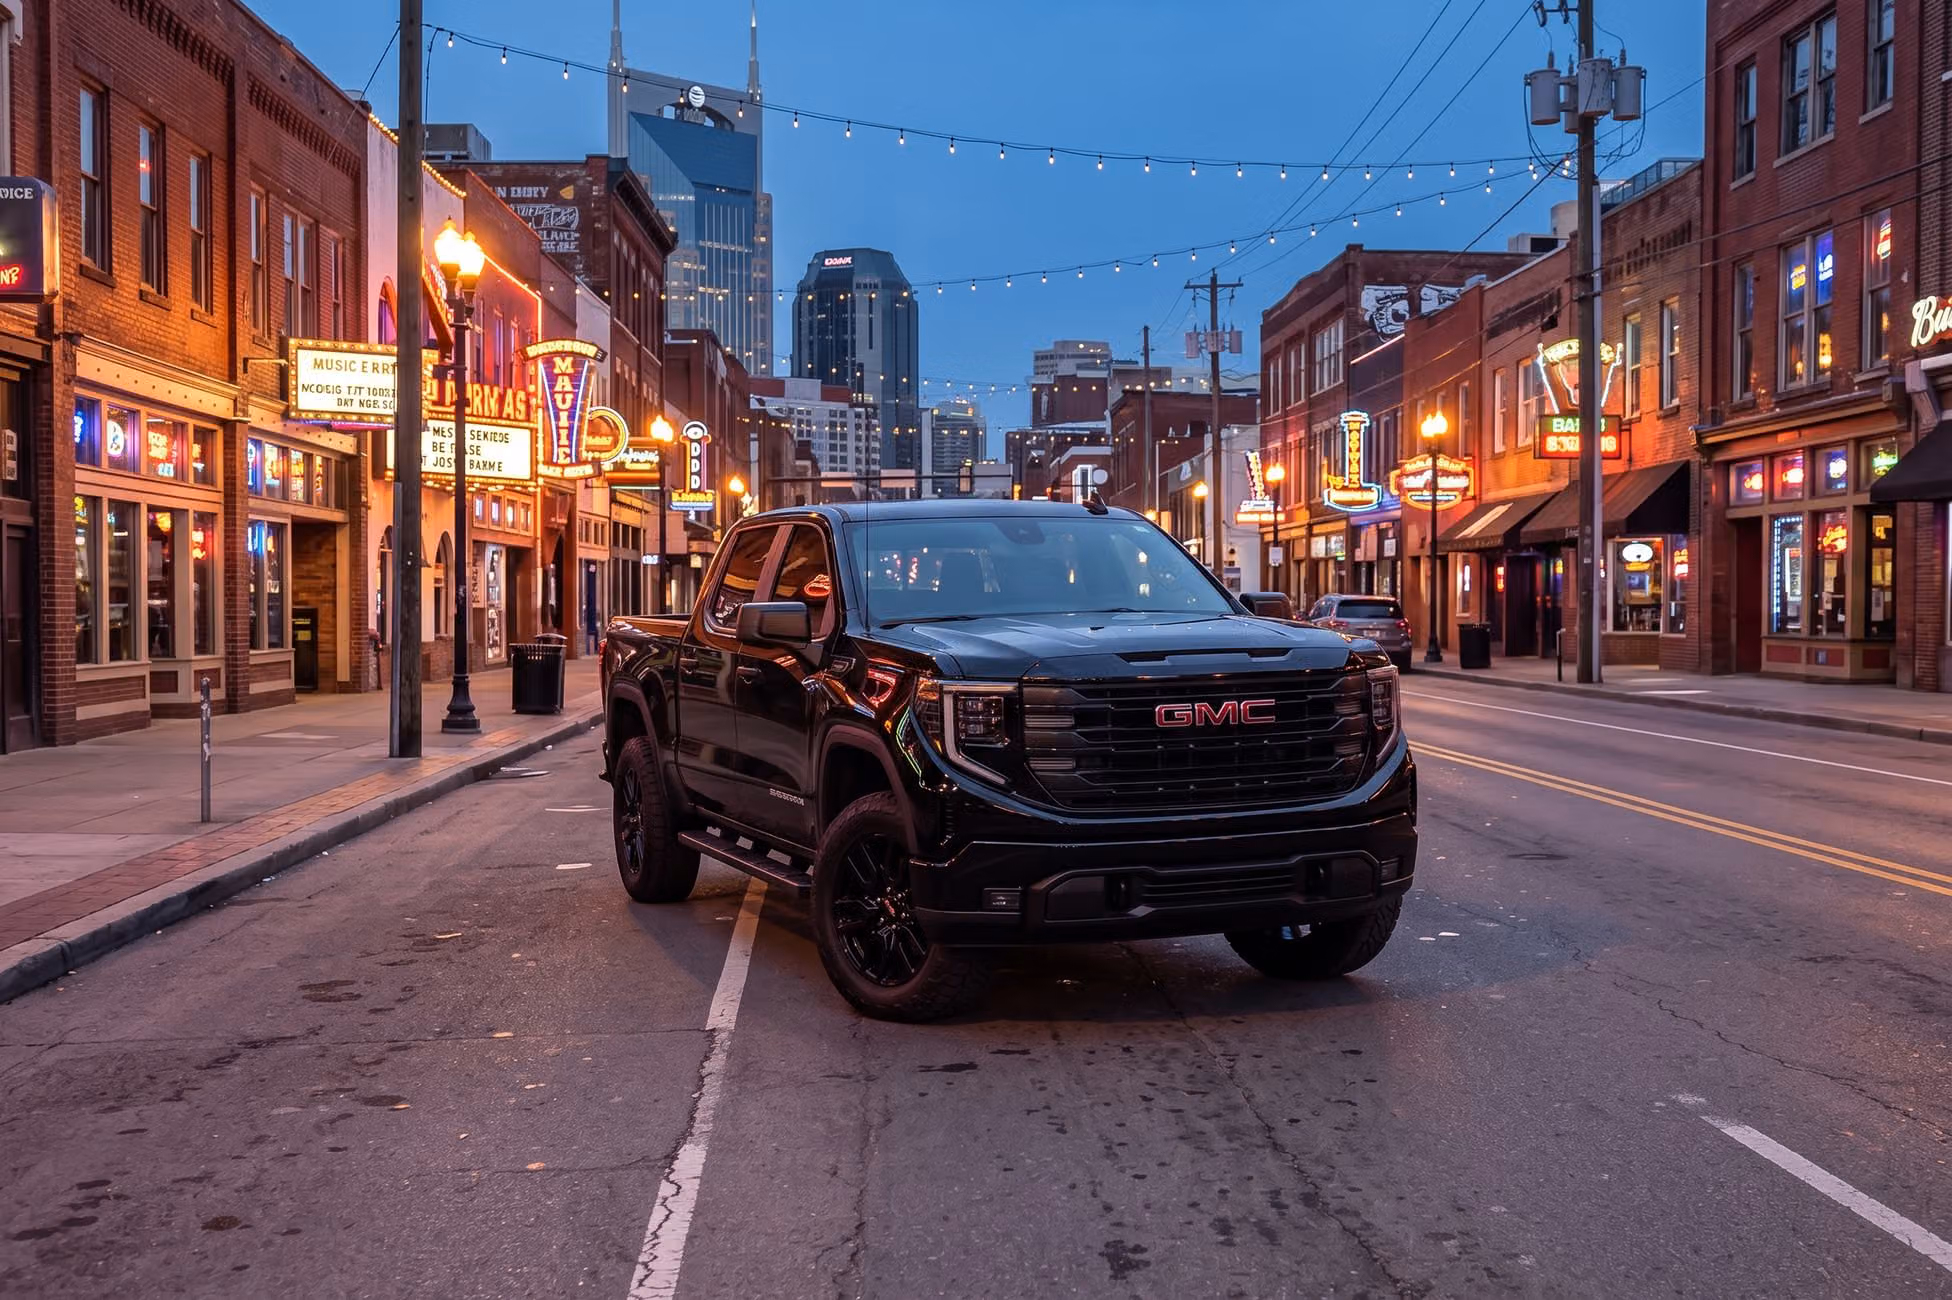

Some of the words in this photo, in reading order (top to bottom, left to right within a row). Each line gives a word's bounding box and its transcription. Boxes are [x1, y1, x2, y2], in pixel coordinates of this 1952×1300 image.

[313, 358, 357, 372] MUSIC
[432, 442, 445, 453] BE
[1155, 699, 1276, 728] GMC
